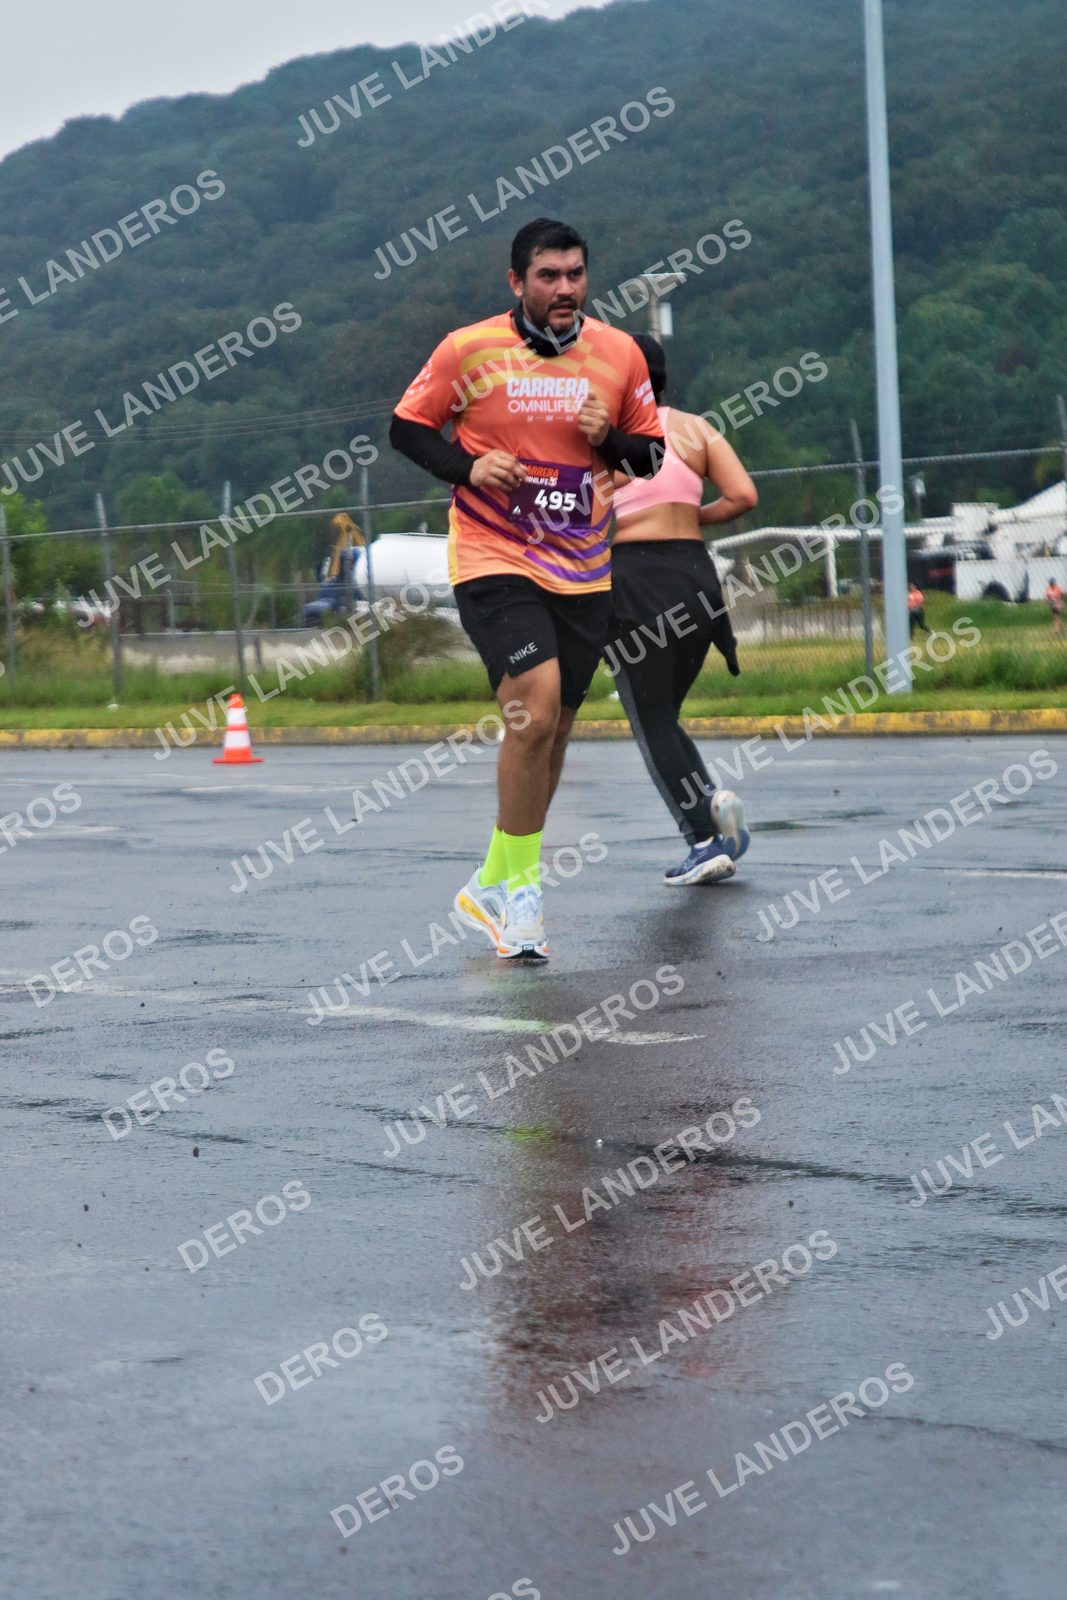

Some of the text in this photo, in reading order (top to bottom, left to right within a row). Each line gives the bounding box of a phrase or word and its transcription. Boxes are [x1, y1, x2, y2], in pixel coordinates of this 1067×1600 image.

[507, 376, 589, 398] CARRERA
[507, 399, 572, 413] OMNILIFE
[534, 488, 577, 513] 495
[509, 641, 539, 665] NIKE
